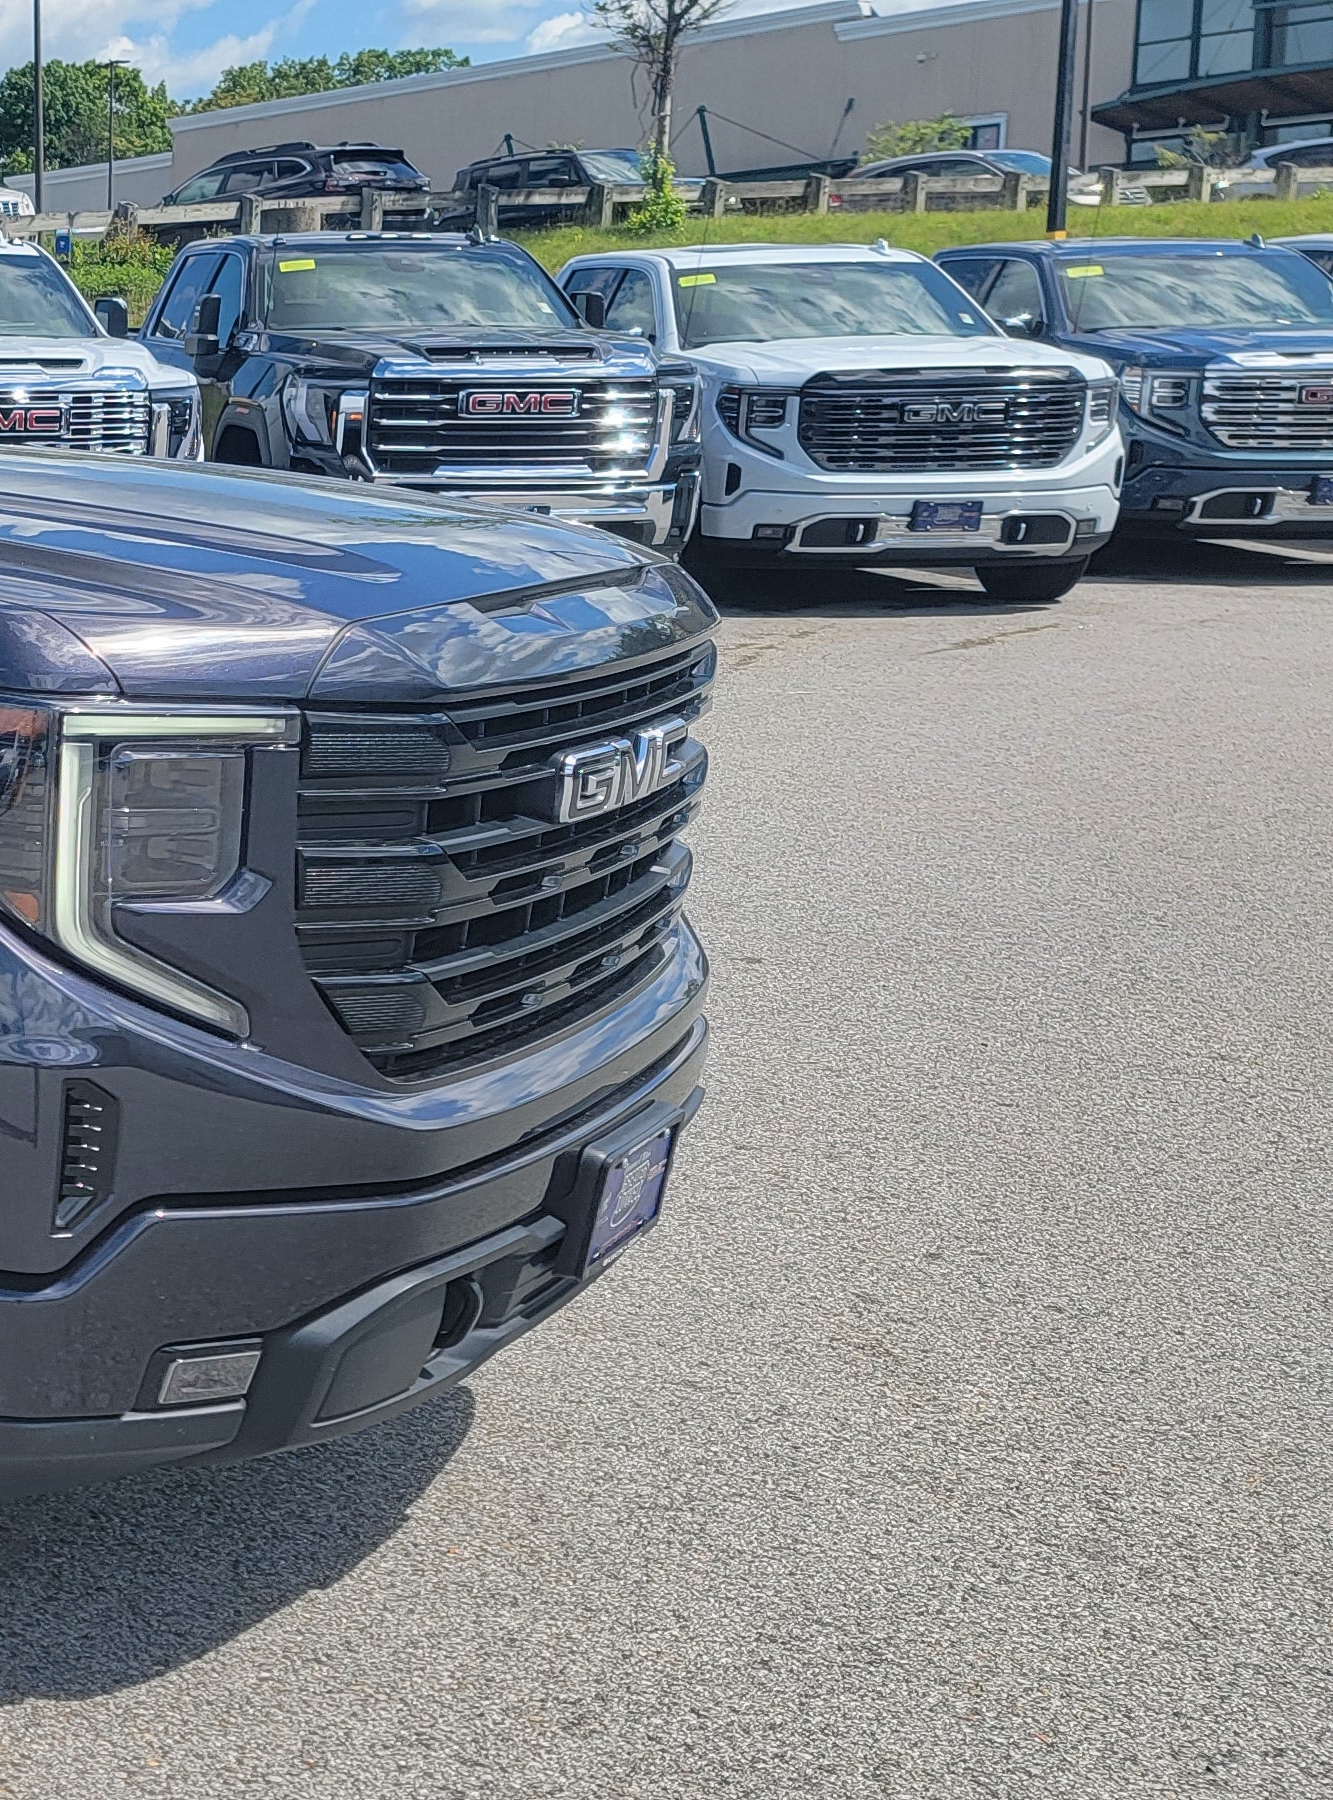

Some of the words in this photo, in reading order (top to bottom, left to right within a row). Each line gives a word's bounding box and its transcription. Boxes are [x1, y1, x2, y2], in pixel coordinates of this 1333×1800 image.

[470, 393, 574, 413] GMC
[903, 403, 1006, 423] GMC
[559, 717, 687, 823] GMC
